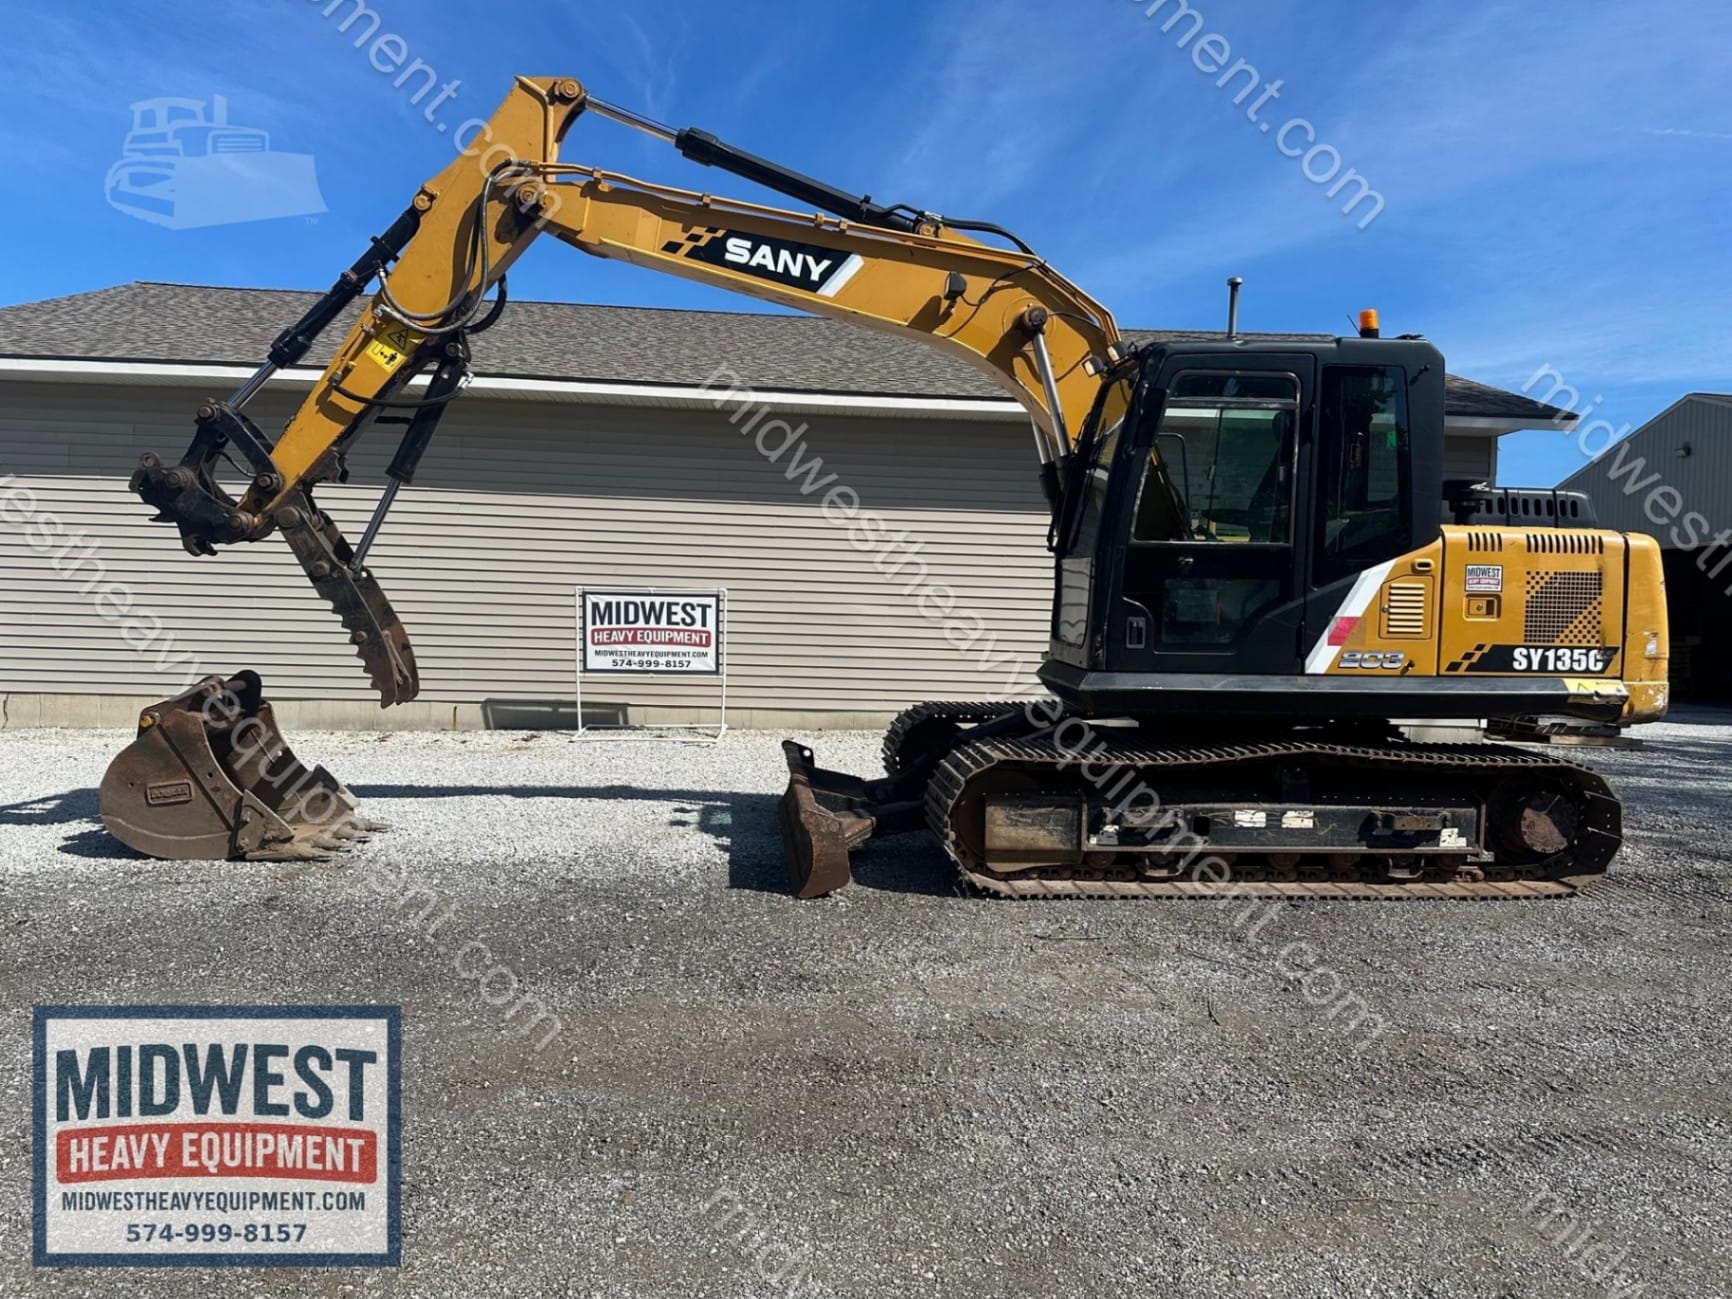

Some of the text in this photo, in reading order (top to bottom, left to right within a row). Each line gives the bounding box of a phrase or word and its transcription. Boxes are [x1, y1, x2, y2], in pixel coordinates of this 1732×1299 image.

[724, 237, 832, 282] SANY
[1467, 567, 1501, 577] MIDWEST
[591, 600, 712, 628] MIDWEST
[594, 630, 708, 645] HEAVY EQUIPMENT
[594, 649, 708, 658] MIDWESTHEAVYEQUIPMENT.COM
[1512, 647, 1604, 672] SY135C
[611, 659, 691, 668] 574-999-8157
